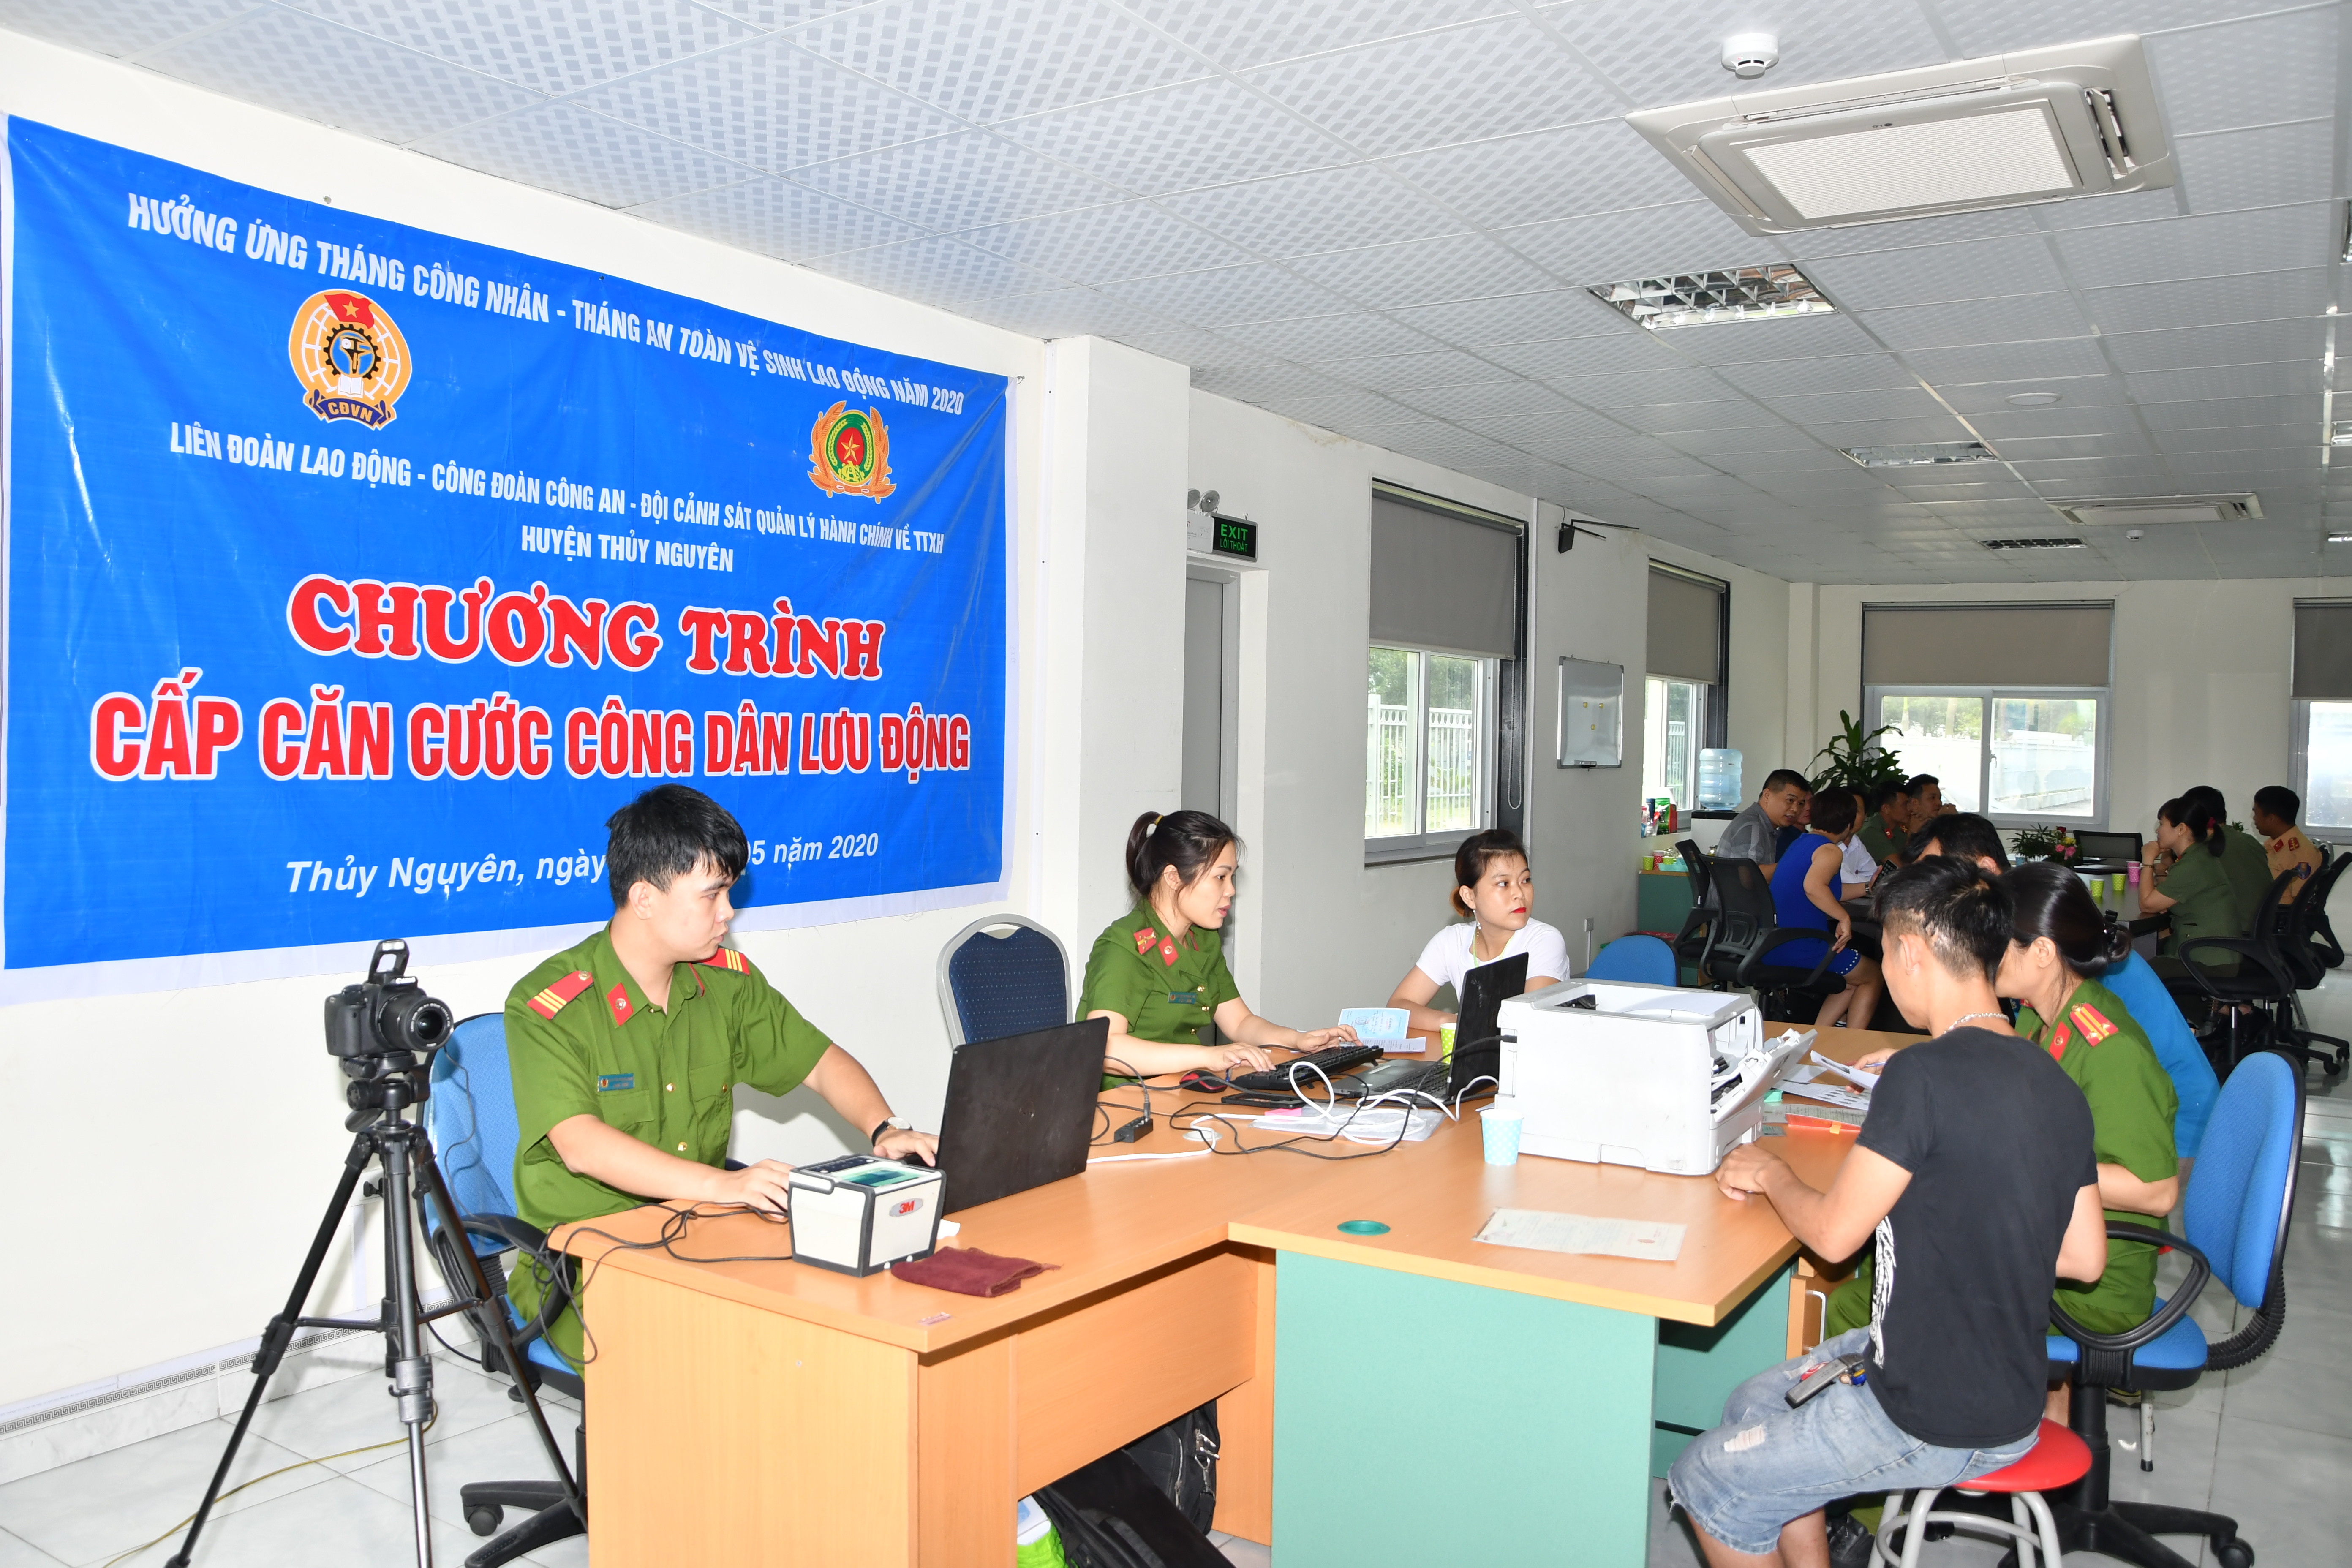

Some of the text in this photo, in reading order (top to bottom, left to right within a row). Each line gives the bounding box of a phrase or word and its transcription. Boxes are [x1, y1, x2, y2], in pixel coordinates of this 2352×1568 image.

[129, 193, 237, 253] HƯỞNG
[245, 219, 307, 269] ỨNG
[317, 241, 405, 291] THÁNG
[414, 263, 479, 308] CÔNG
[485, 281, 549, 322] NHÂN
[572, 300, 640, 342] THÁNG
[647, 320, 673, 351] AN
[680, 327, 731, 364] TOÀN
[735, 340, 759, 375] VỆ
[763, 350, 806, 381] SINH
[807, 362, 840, 388] LAO
[842, 368, 890, 399] ĐỘNG
[890, 378, 928, 407] NĂM
[931, 387, 964, 414] 2020
[327, 401, 373, 422] CĐVN
[171, 422, 221, 459] LIÊN
[227, 433, 294, 471] ĐOÀN
[300, 445, 345, 477] LAO
[352, 449, 410, 488] ĐỘNG
[433, 460, 485, 496] CÔNG
[491, 471, 539, 503] ĐOÀN
[546, 477, 593, 510] CÔNG
[599, 488, 624, 514] AN
[641, 490, 668, 524] ĐỘI
[674, 492, 719, 525] CẢNH
[724, 505, 751, 530] SÁT
[757, 506, 795, 536] QUẢN
[799, 516, 814, 538] LÝ
[820, 518, 856, 543] HÀNH
[860, 524, 893, 548] CHÍNH
[896, 526, 910, 550] VỀ
[913, 531, 944, 553] TTXH
[522, 525, 733, 571] HUYỆN THỦY NGUYÊN
[1221, 524, 1248, 541] EXIT
[1230, 540, 1248, 552] THOÁT
[287, 574, 885, 679] CHƯƠNG TRÌNH
[91, 667, 970, 784] CẤP CĂN CƯỚC CÔNG DÂN LƯU ĐỘNG
[287, 833, 878, 897] Thủy Nguyên, ngày 5 năm 2020
[899, 1200, 915, 1213] 3M
